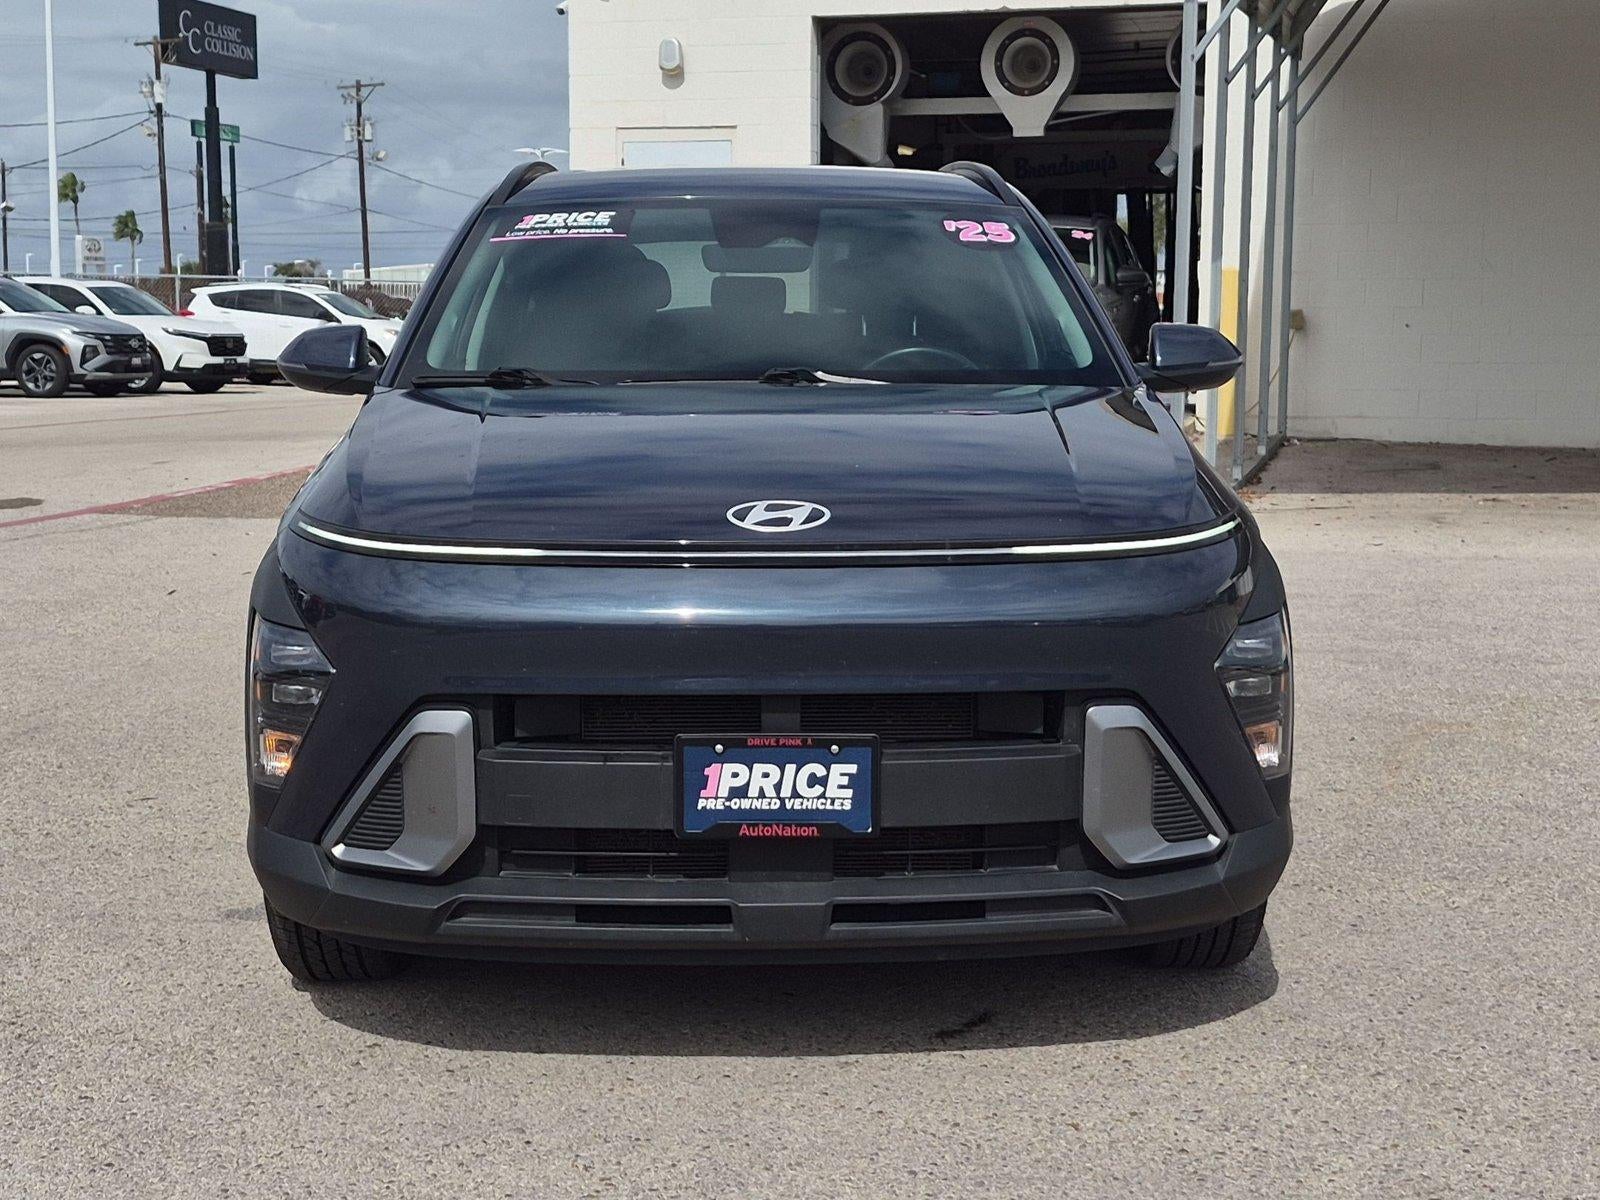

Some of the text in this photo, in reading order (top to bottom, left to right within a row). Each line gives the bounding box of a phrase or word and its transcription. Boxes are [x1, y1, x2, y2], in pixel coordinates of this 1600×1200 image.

[204, 20, 242, 42] CLASSIC
[204, 37, 255, 60] COLLISION
[943, 220, 1016, 243] '25
[747, 737, 802, 746] DRIVE PINK
[700, 762, 858, 798] 1PRICE
[697, 798, 852, 810] PRE-OWNED VEHICLES
